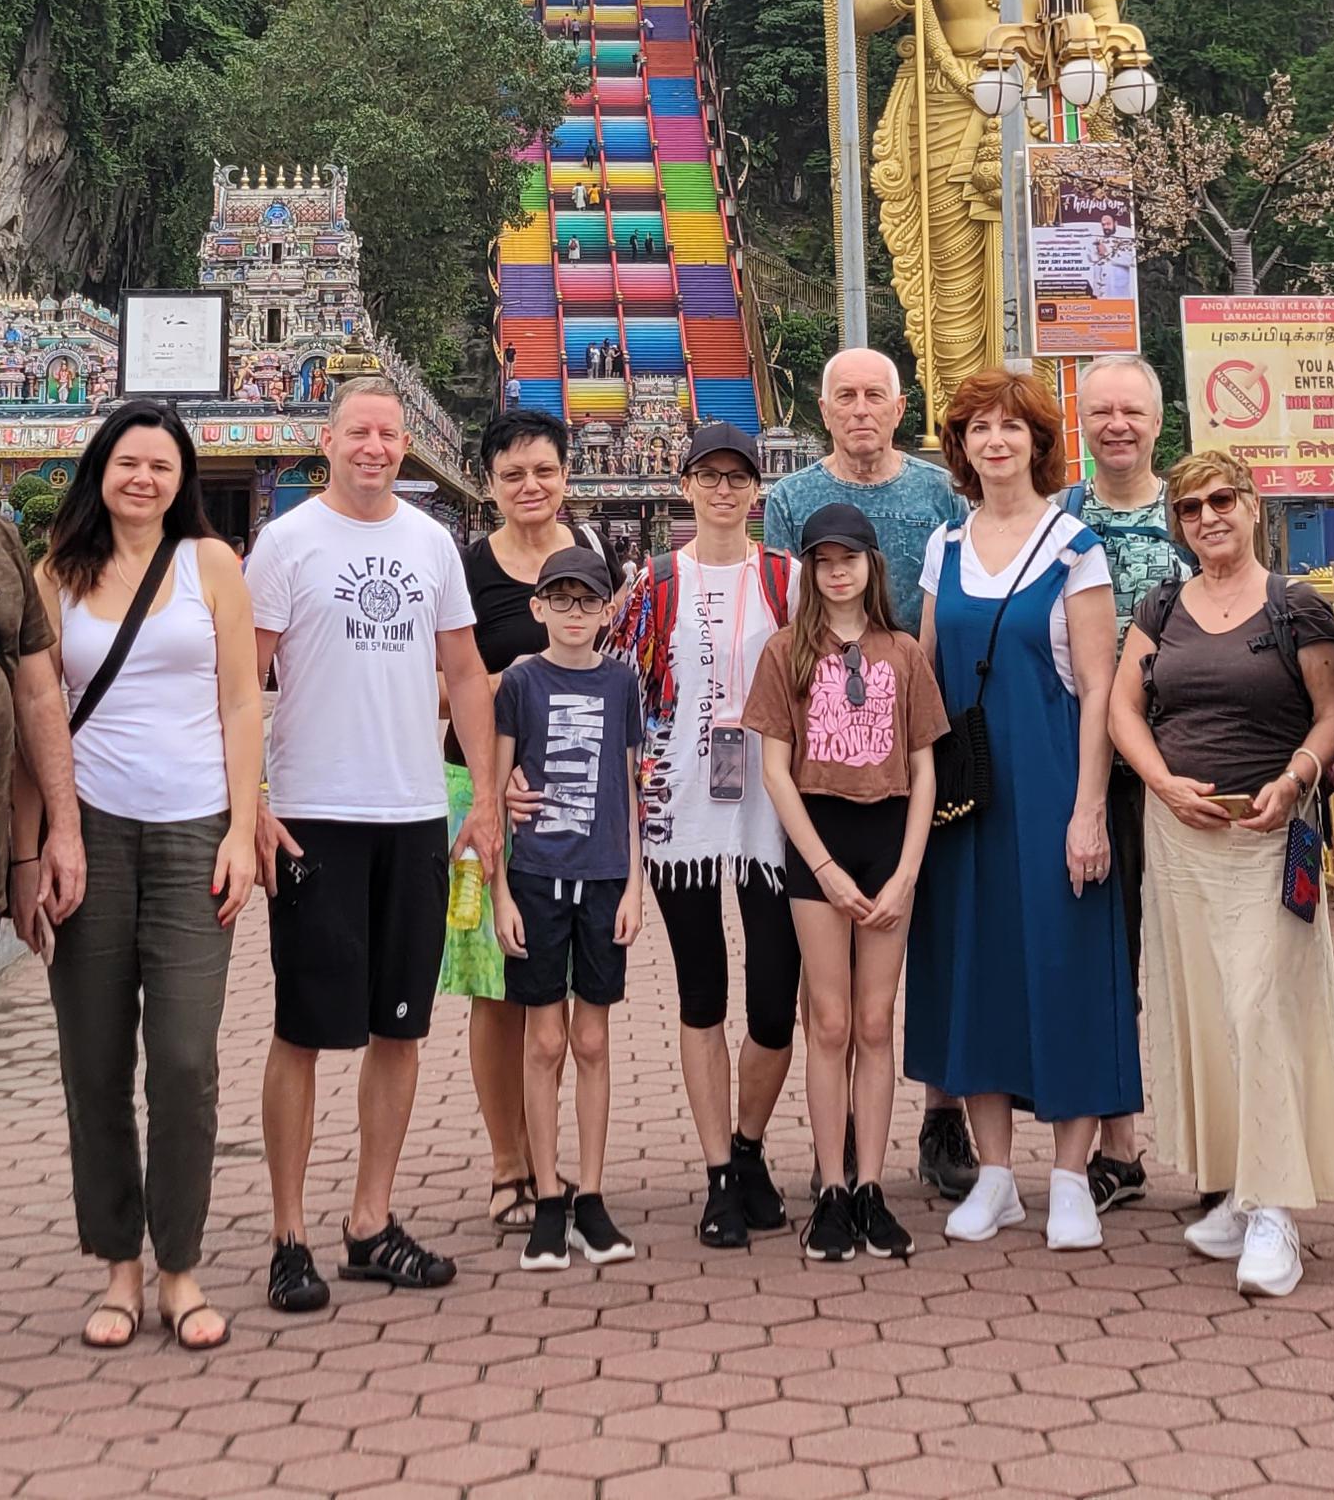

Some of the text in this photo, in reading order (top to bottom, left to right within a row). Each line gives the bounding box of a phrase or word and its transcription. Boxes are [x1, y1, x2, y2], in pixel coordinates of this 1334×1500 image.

[1200, 302, 1230, 310] ANDA
[1233, 302, 1285, 310] MEMASUKI
[1287, 302, 1299, 310] KE
[1223, 312, 1332, 321] LARANGAN MEROKOK
[1298, 359, 1323, 372] YOU
[1215, 370, 1263, 419] NO SMOKING
[334, 557, 424, 604] HILFIGER
[346, 616, 414, 641] NEW YORK
[382, 642, 405, 652] AVENUE
[852, 712, 875, 726] THE
[807, 725, 893, 762] FLOWERS
